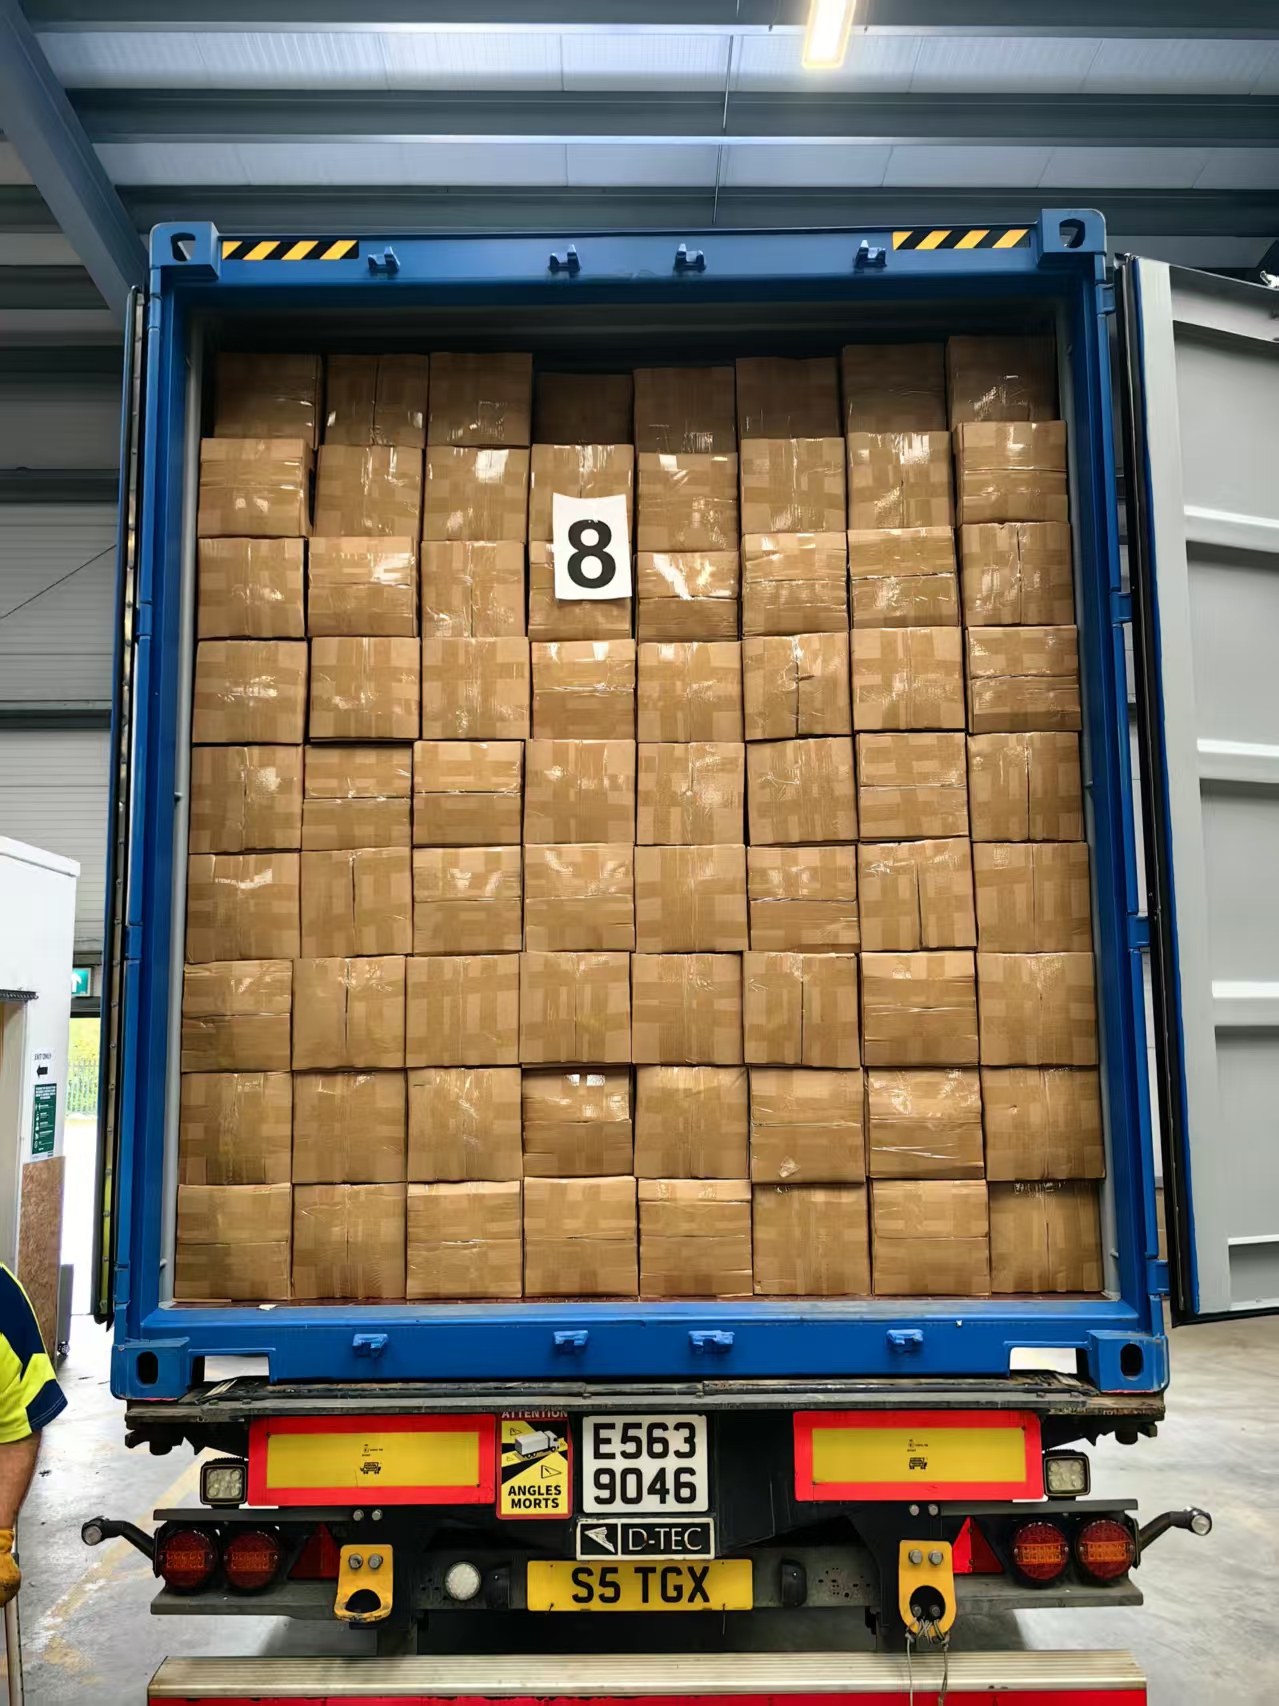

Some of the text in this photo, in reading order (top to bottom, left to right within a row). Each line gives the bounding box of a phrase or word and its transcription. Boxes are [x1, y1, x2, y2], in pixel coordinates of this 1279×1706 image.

[567, 519, 616, 589] 8
[593, 1422, 697, 1460] E563
[508, 1484, 562, 1496] ANGLES
[511, 1497, 560, 1509] MORTS
[593, 1467, 697, 1505] 9046
[628, 1527, 703, 1551] D-TEC
[571, 1566, 711, 1604] S5 TGX
